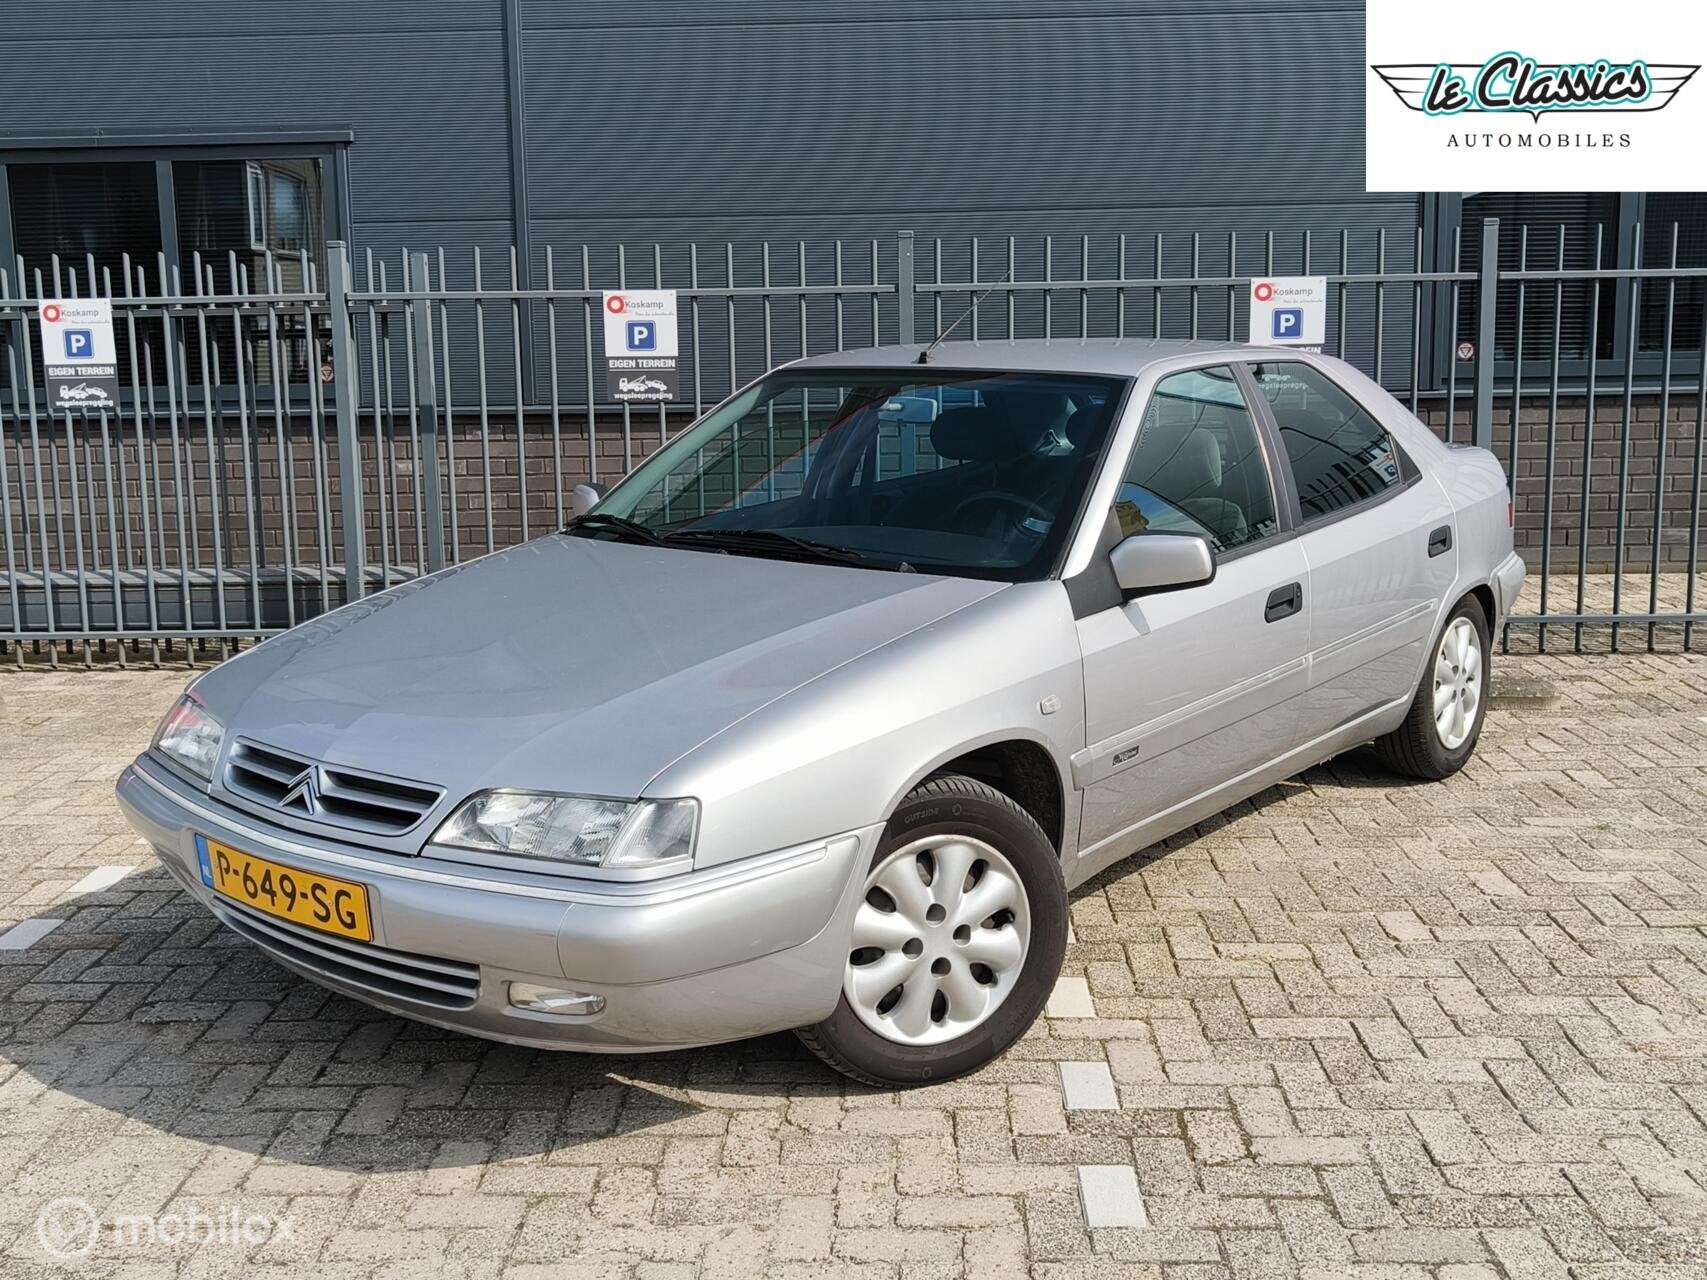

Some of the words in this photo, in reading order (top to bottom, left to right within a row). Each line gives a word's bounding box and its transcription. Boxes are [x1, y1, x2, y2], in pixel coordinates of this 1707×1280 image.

[1273, 288, 1313, 297] Koskamp
[625, 300, 664, 309] Koskamp
[61, 308, 99, 318] Koskamp
[1280, 313, 1296, 333] P
[633, 326, 648, 346] P
[70, 334, 86, 353] P
[608, 359, 636, 368] EIGEN
[637, 359, 676, 368] TERREIN
[48, 367, 75, 376] EIGEN
[76, 366, 115, 376] TERREIN
[216, 850, 357, 930] P-649-SG
